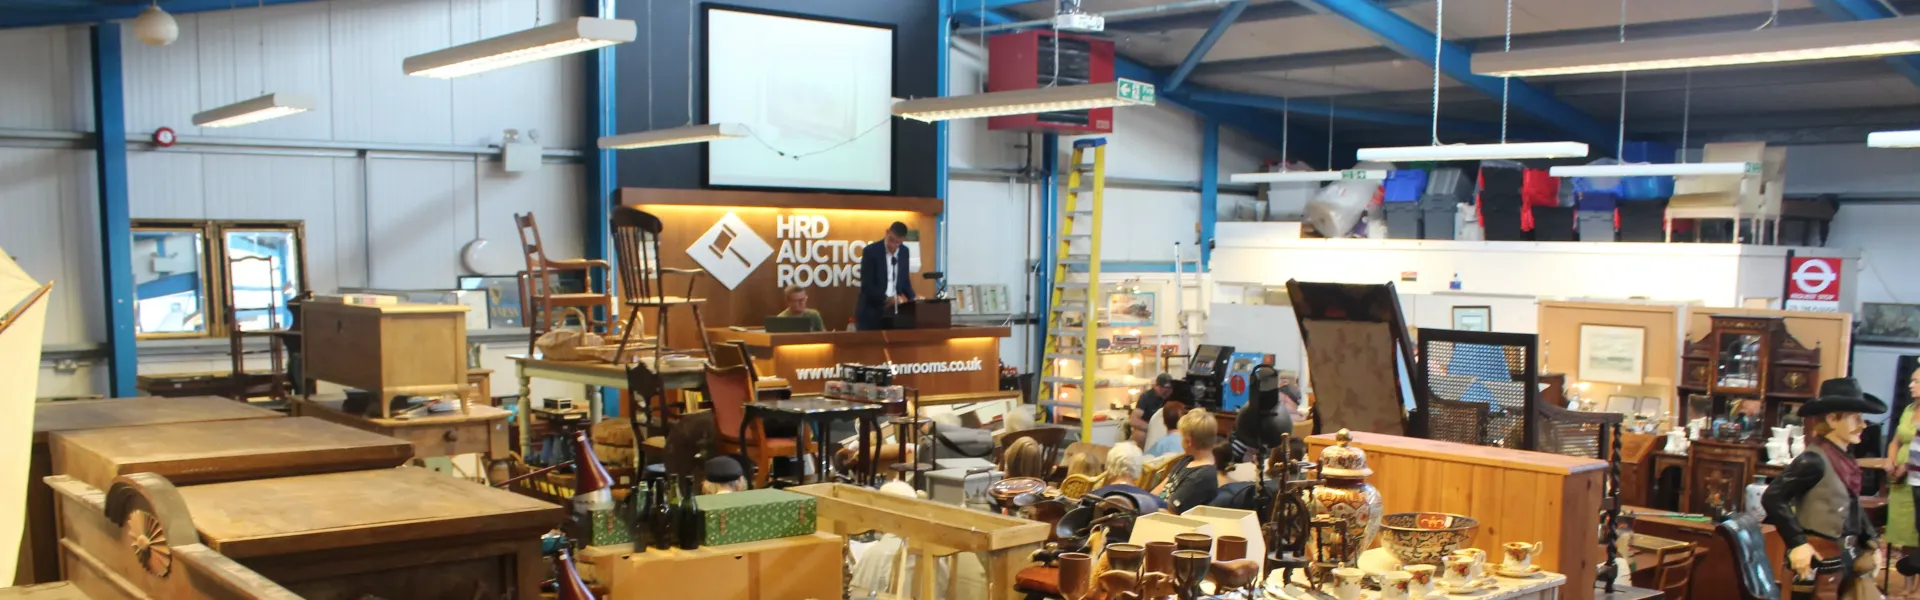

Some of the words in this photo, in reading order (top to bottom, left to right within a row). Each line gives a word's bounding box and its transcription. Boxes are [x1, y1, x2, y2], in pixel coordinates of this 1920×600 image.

[776, 215, 830, 239] HRD
[776, 239, 874, 264] AUCTIO
[777, 263, 862, 288] ROOMS
[796, 357, 981, 379] www.hionrooms.co.uk
